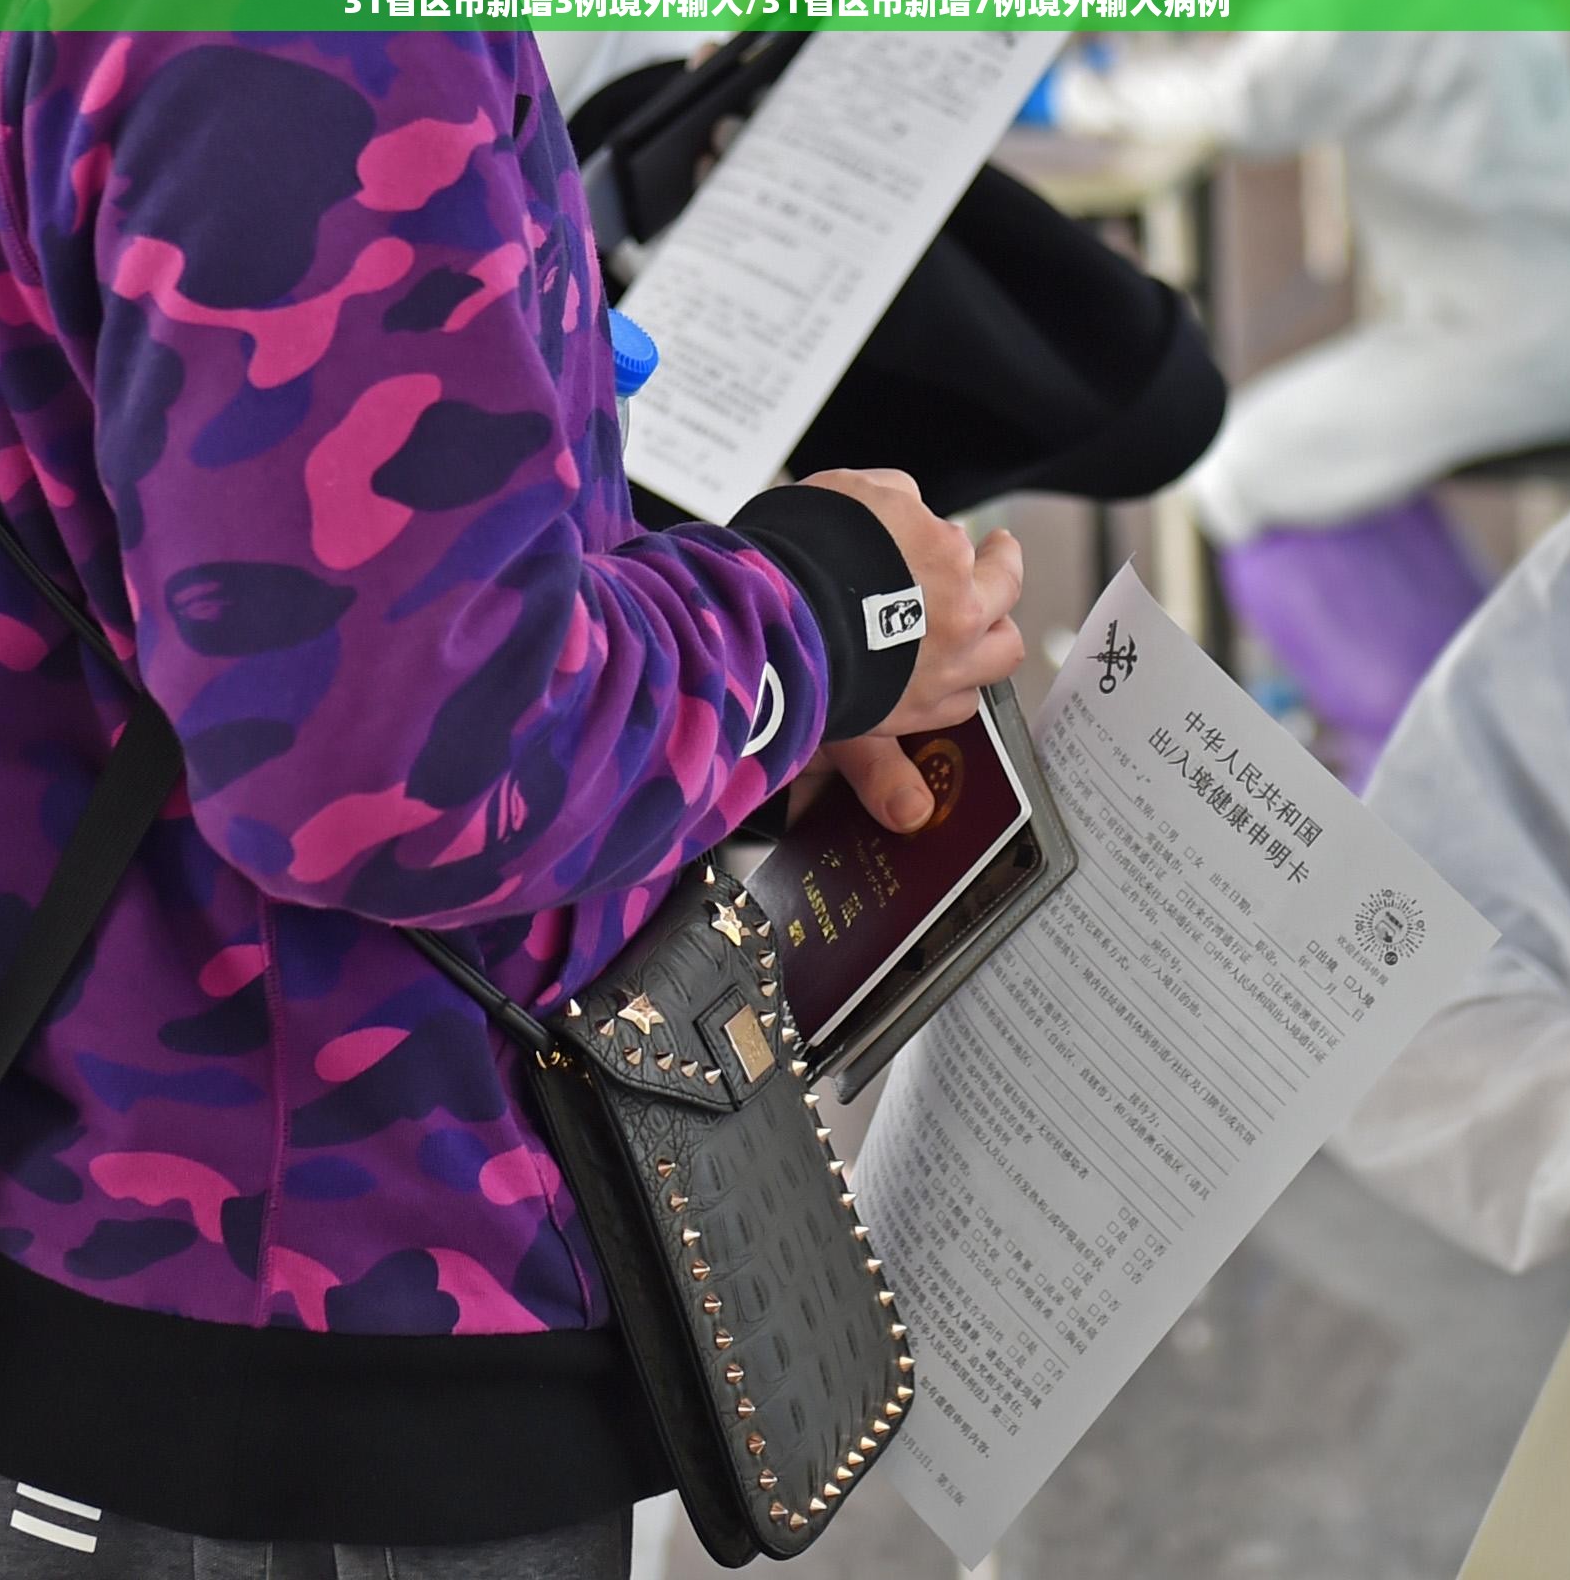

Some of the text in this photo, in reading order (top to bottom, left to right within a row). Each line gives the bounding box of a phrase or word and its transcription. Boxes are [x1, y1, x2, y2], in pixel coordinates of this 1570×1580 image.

[1178, 707, 1324, 848] 中华人民共和国
[1145, 725, 1314, 889] 出/入境健康申明卡
[802, 870, 839, 944] PASSPORT
[1189, 853, 1207, 870] 女
[1207, 871, 1254, 918] 出生日期：
[1321, 979, 1338, 996] 月
[1350, 1007, 1365, 1023] 日
[1252, 939, 1280, 967] 职业：
[1334, 933, 1390, 988] 欢迎扫码申报
[1313, 947, 1377, 1010] 出境 入境
[1269, 980, 1341, 1050] 往来港澳通行证
[1114, 1229, 1129, 1245] 是
[1141, 1256, 1156, 1271] 否
[1125, 1215, 1141, 1231] 是
[1152, 1242, 1167, 1257] 否
[1079, 1270, 1121, 1312] 是 否
[1102, 1243, 1118, 1259] 是
[1129, 1270, 1144, 1285] 否
[1068, 1284, 1085, 1301] 是
[1095, 1312, 1110, 1327] 否
